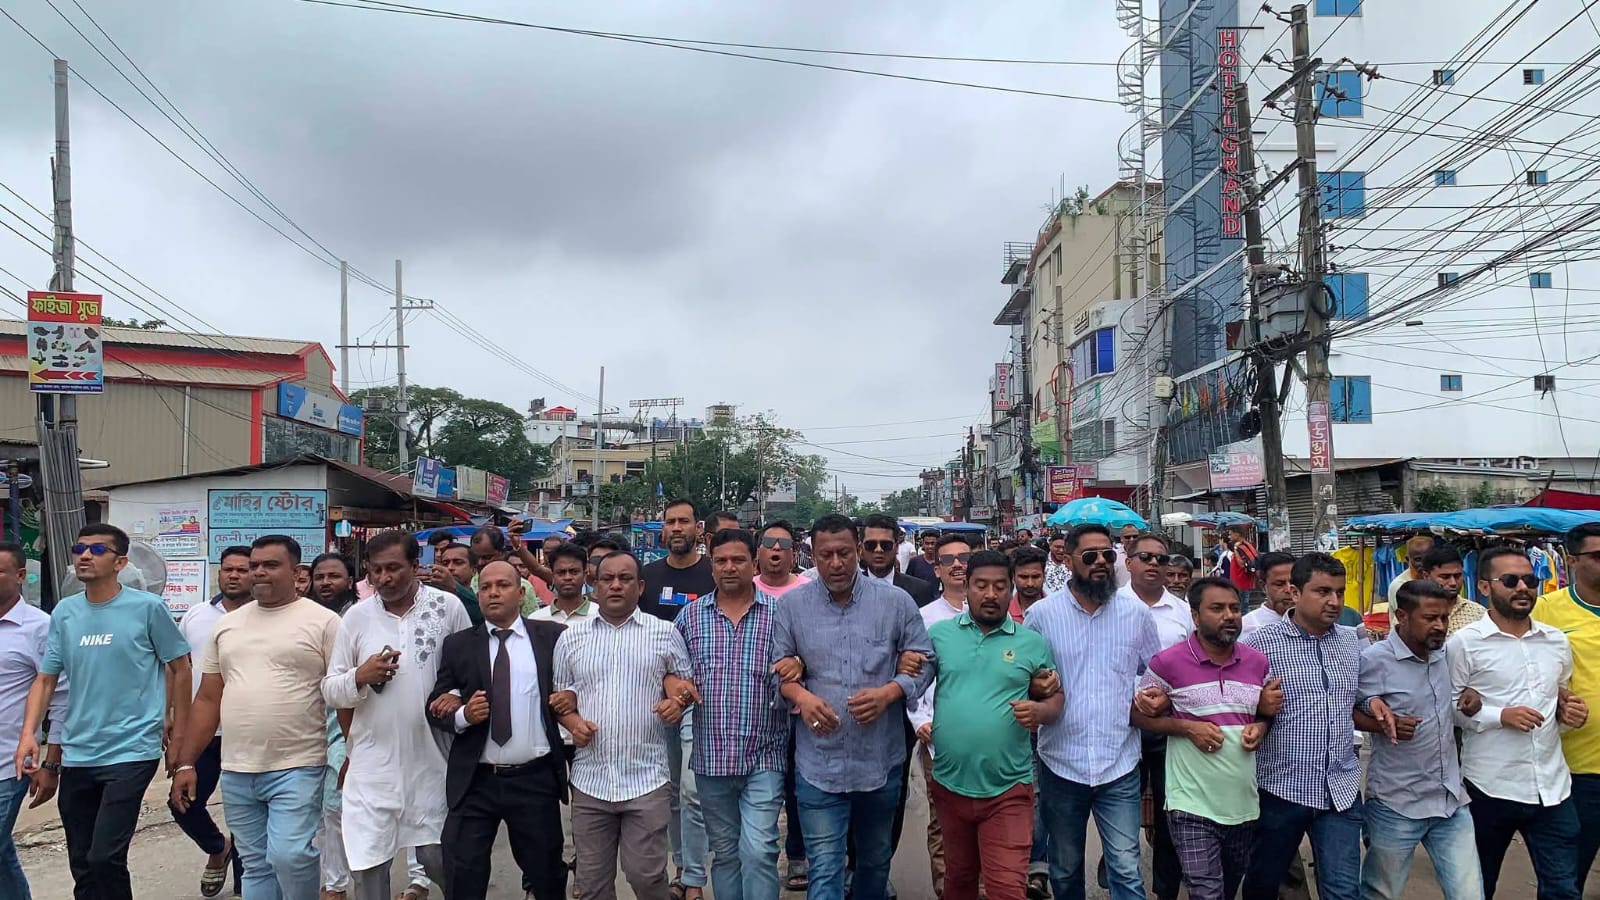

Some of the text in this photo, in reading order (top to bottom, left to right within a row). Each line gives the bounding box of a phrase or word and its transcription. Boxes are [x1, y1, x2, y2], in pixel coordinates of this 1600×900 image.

[1218, 31, 1241, 234] HOTEL GRAND
[30, 295, 99, 320] ফাইজা সুজ
[79, 633, 113, 647] NIKE
